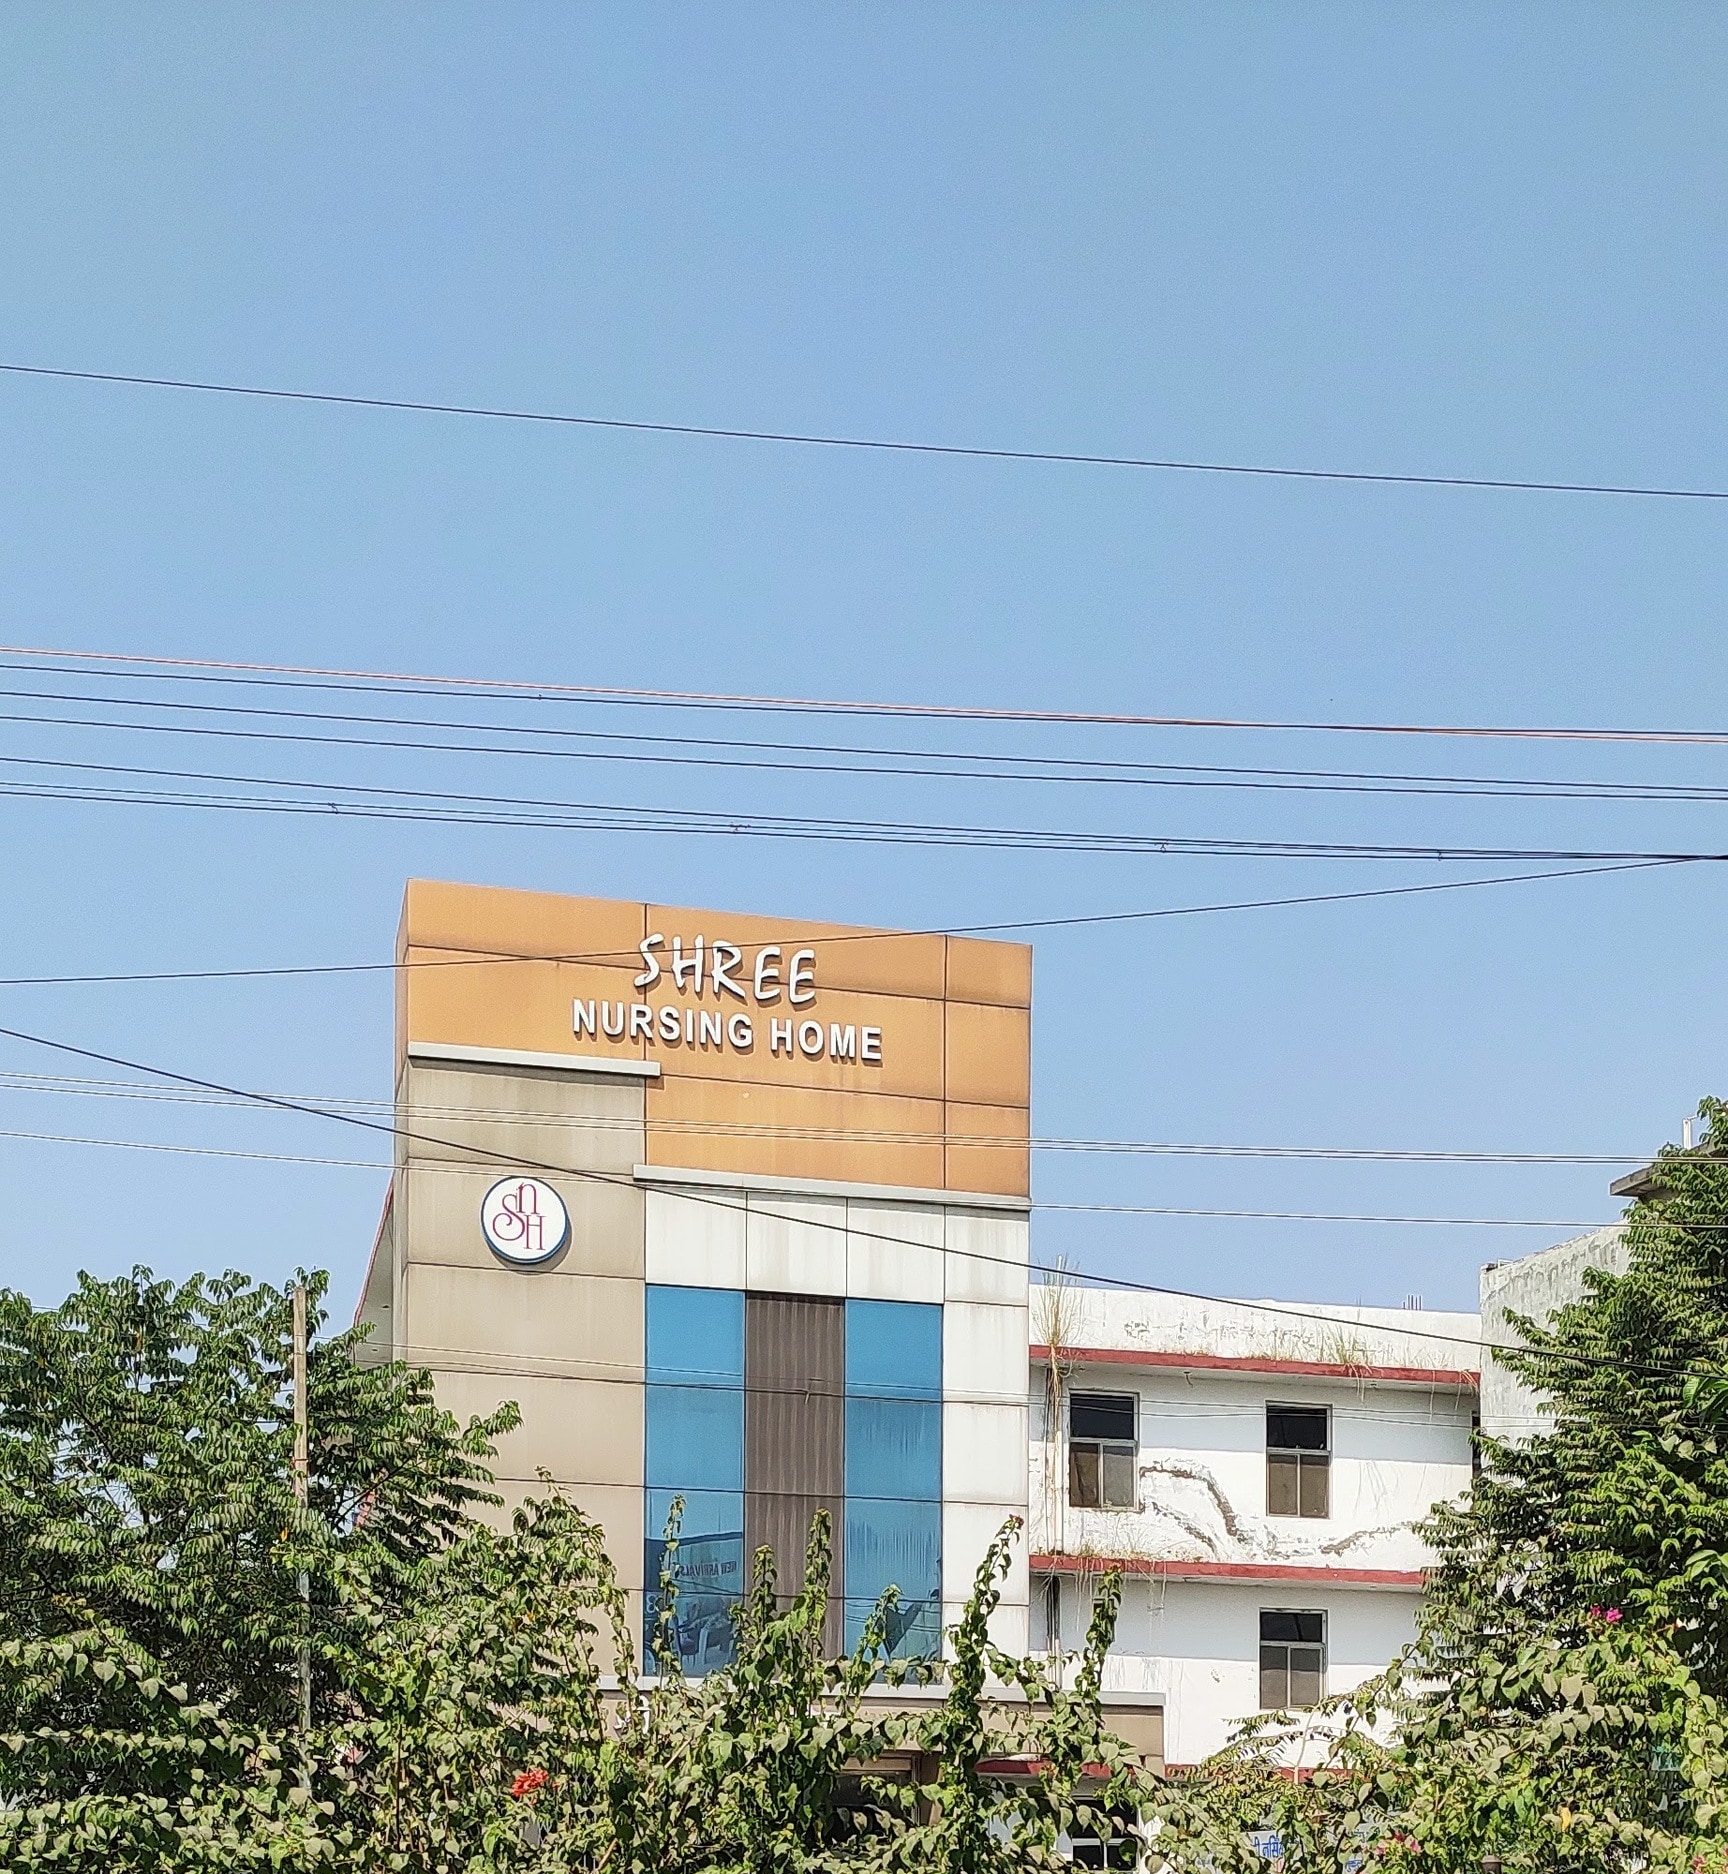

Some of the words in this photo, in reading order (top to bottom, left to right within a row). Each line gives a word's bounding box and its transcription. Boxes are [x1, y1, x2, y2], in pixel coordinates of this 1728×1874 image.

[633, 933, 816, 1004] SHREE
[573, 998, 753, 1048] NURSING
[770, 1017, 882, 1060] HOME
